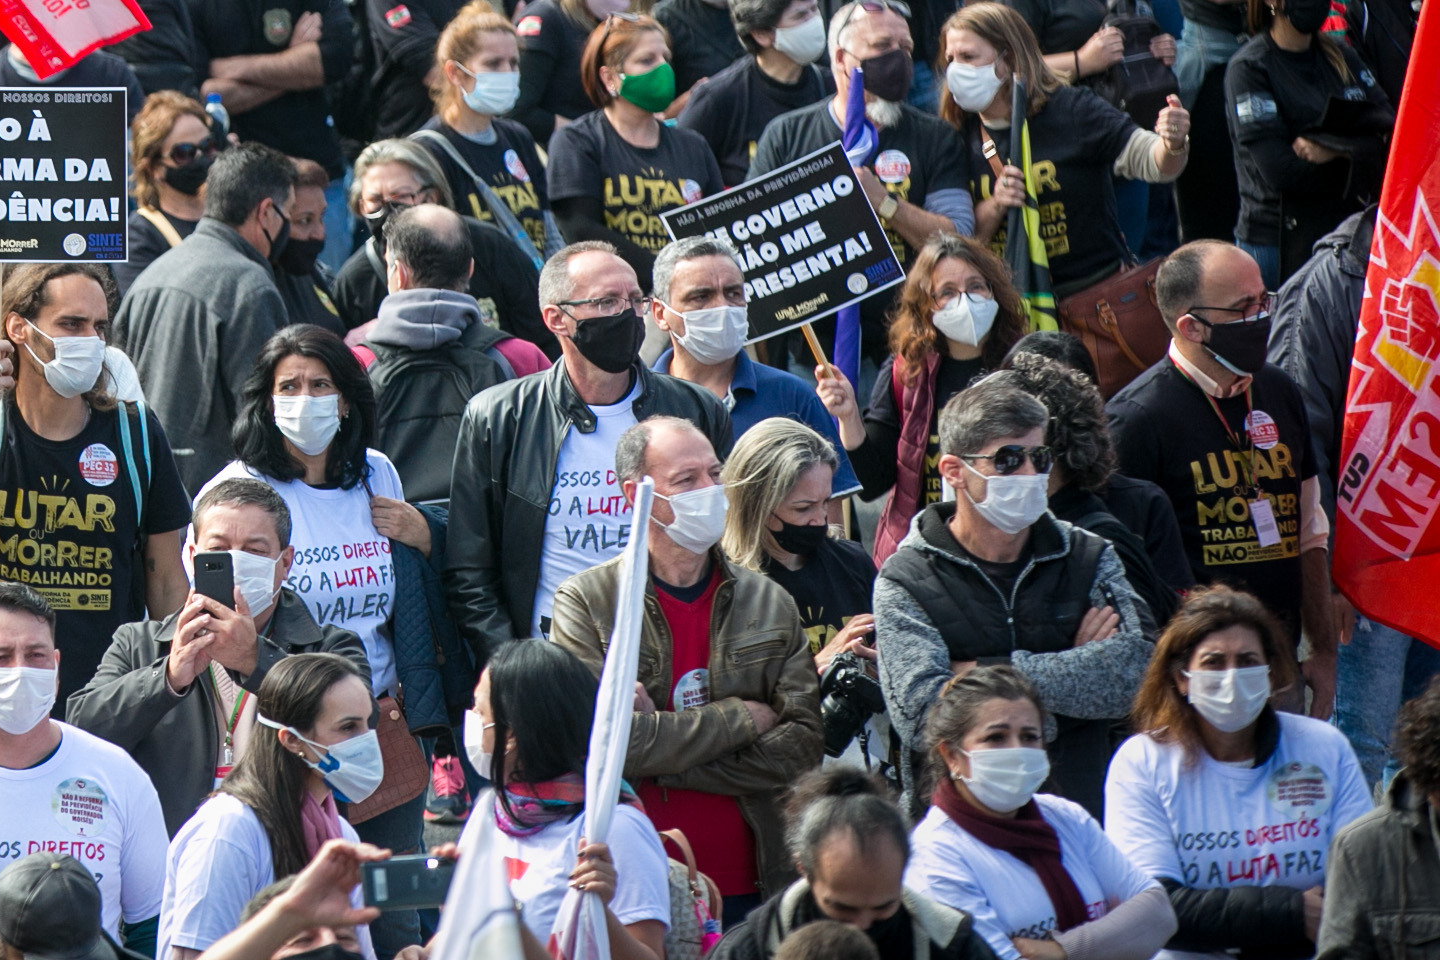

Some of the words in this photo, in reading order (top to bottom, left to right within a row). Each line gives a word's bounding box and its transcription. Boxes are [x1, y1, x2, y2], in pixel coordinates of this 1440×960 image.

[3, 93, 50, 103] NOSSOS
[55, 93, 112, 103] DIREITOS!
[28, 110, 52, 141] À
[64, 158, 112, 181] DA
[747, 187, 763, 201] DA
[731, 175, 854, 241] GOVERNO
[88, 233, 122, 246] SINTE
[779, 221, 826, 255] ME
[83, 461, 103, 470] PEC
[104, 462, 115, 472] 32
[1190, 442, 1296, 495] LUTAR
[569, 496, 582, 518] A
[29, 529, 44, 539] OU
[564, 524, 631, 553] VALE
[294, 546, 340, 565] OSSOS
[1208, 546, 1247, 563] NÃO
[320, 572, 332, 592] A
[334, 566, 379, 588] LUTA
[316, 593, 389, 624] VALER
[69, 808, 103, 820] GOVERNADOR
[1245, 818, 1320, 846] DIREITOS
[1208, 861, 1223, 886] A
[1227, 853, 1280, 882] LUTA
[1283, 850, 1323, 876] FAZ
